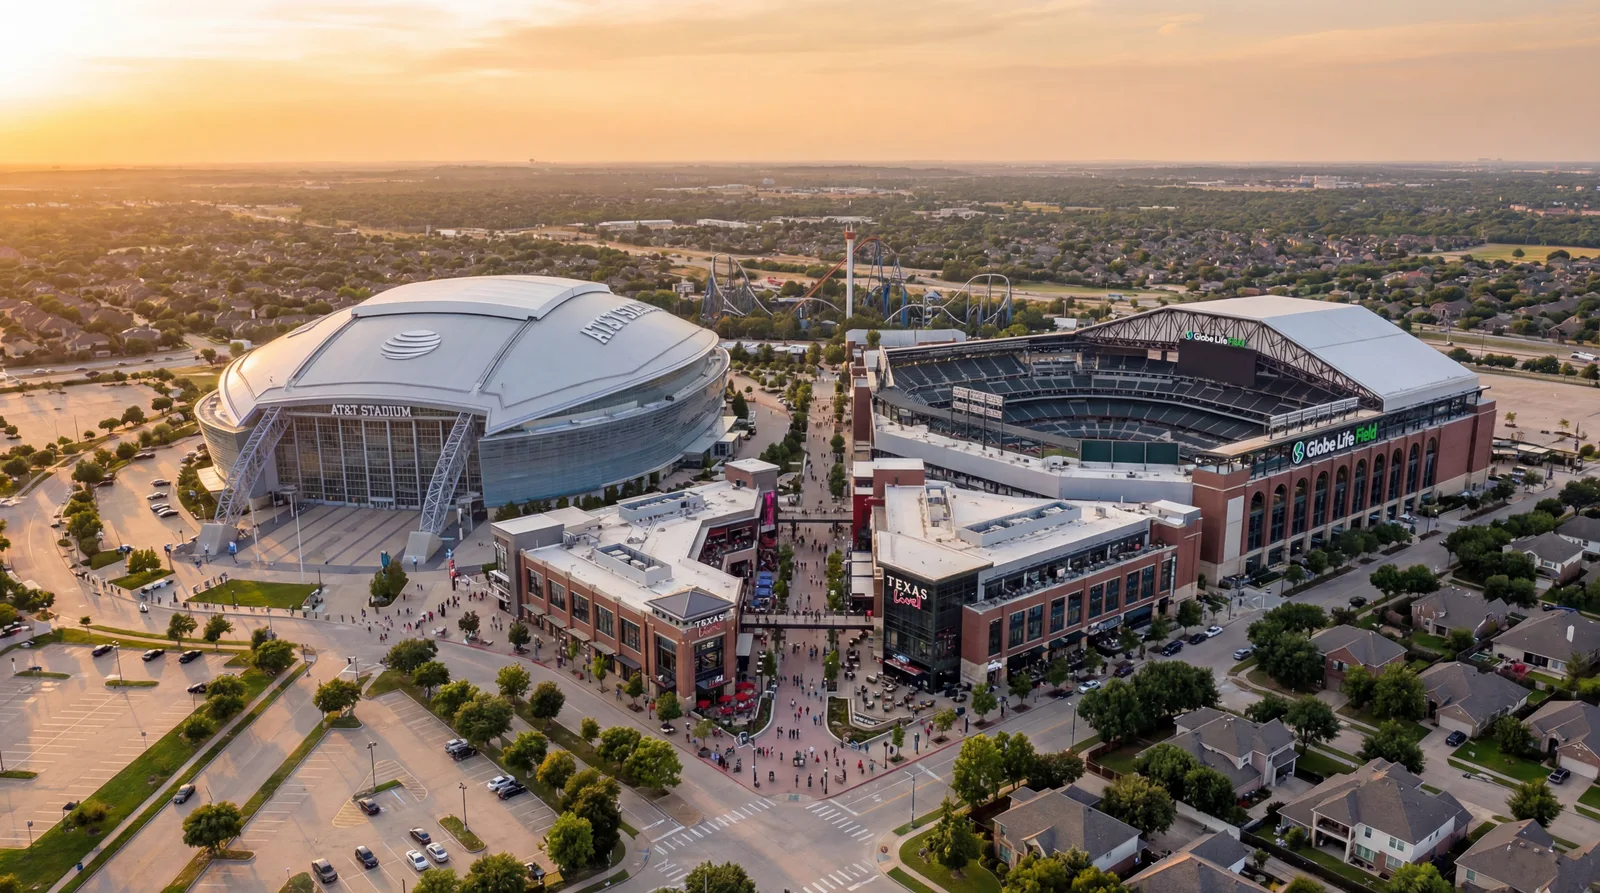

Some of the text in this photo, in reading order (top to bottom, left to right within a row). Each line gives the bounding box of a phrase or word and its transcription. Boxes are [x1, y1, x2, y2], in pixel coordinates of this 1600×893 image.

[580, 312, 628, 345] AT&T
[1194, 332, 1214, 343] Globe
[331, 404, 412, 417] AT&T STADIUM
[1306, 422, 1378, 458] Globe Life Field
[887, 575, 928, 600] TEXAS
[694, 613, 725, 628] TEXAS
